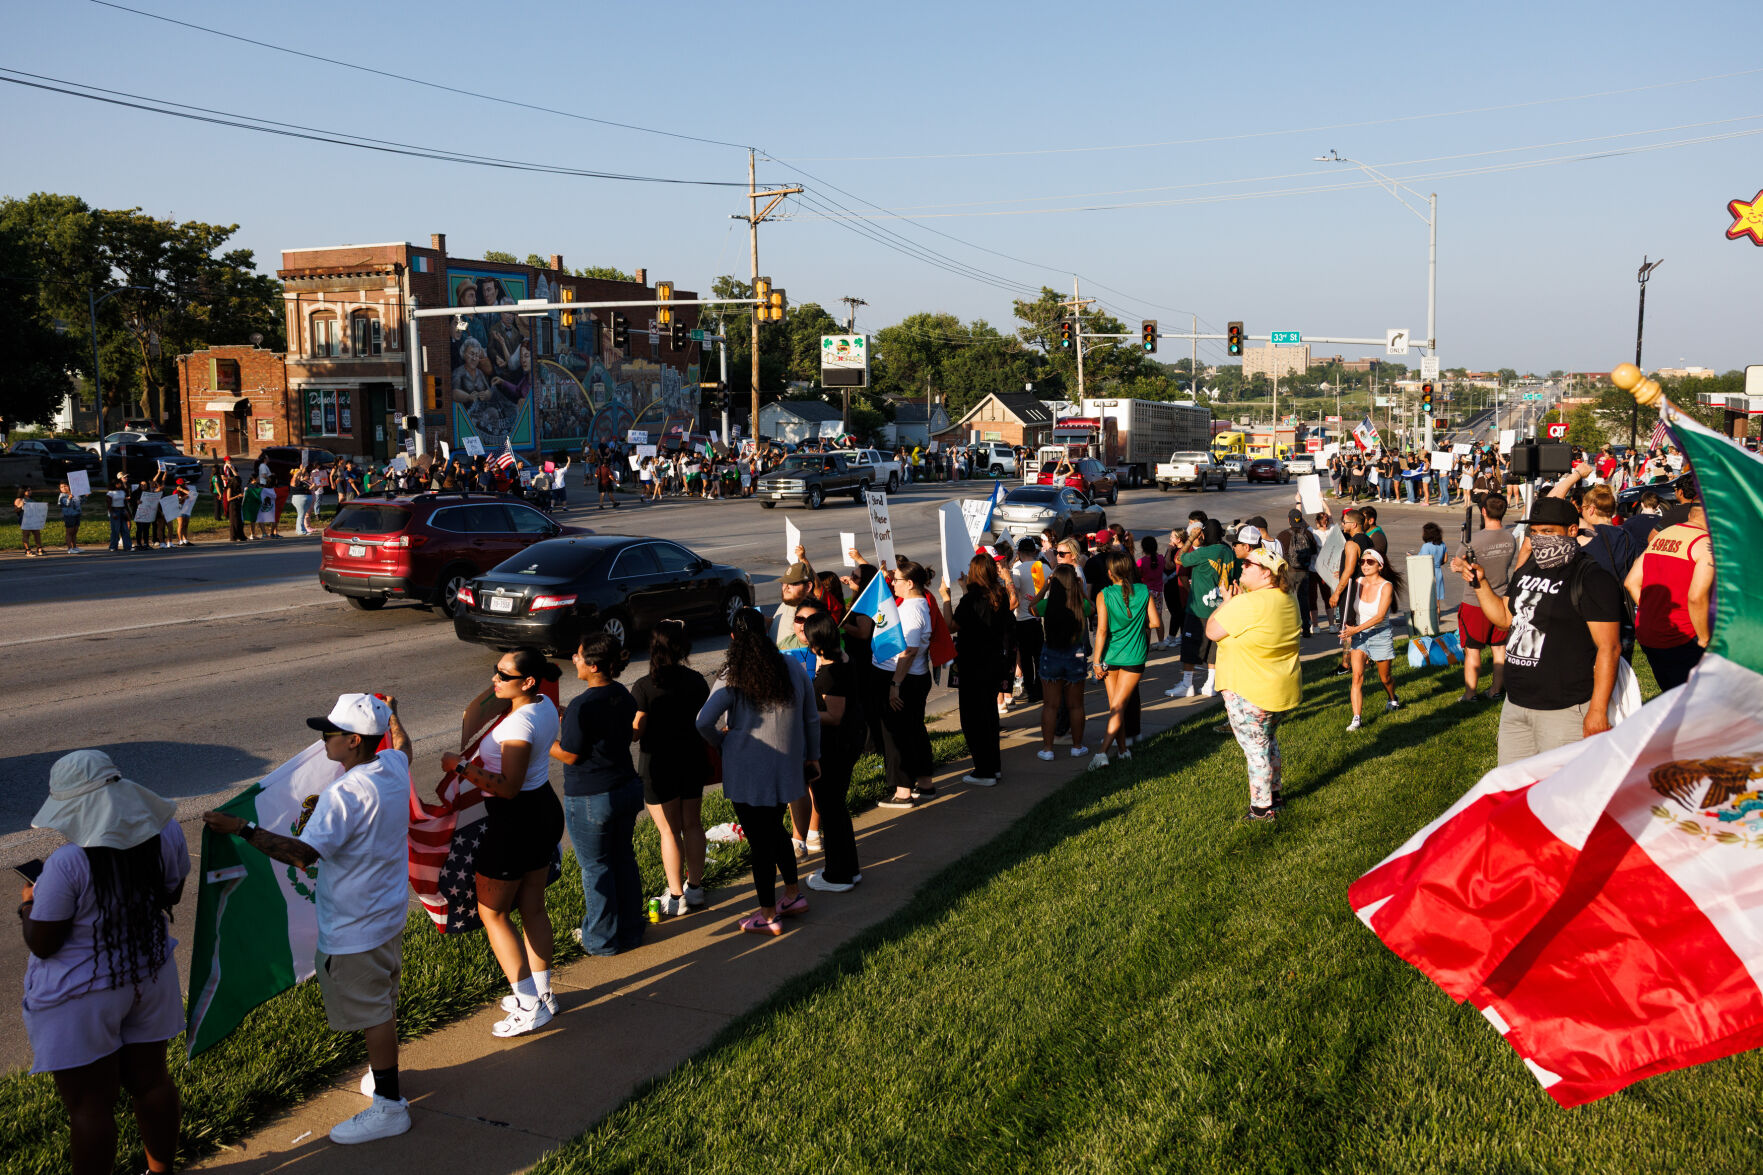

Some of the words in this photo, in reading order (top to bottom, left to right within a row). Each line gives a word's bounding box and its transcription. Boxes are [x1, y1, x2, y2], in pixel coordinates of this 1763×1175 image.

[1273, 333, 1288, 341] 33rd
[1289, 333, 1298, 341] St
[1549, 425, 1567, 437] QT
[1652, 538, 1682, 553] 49ERS
